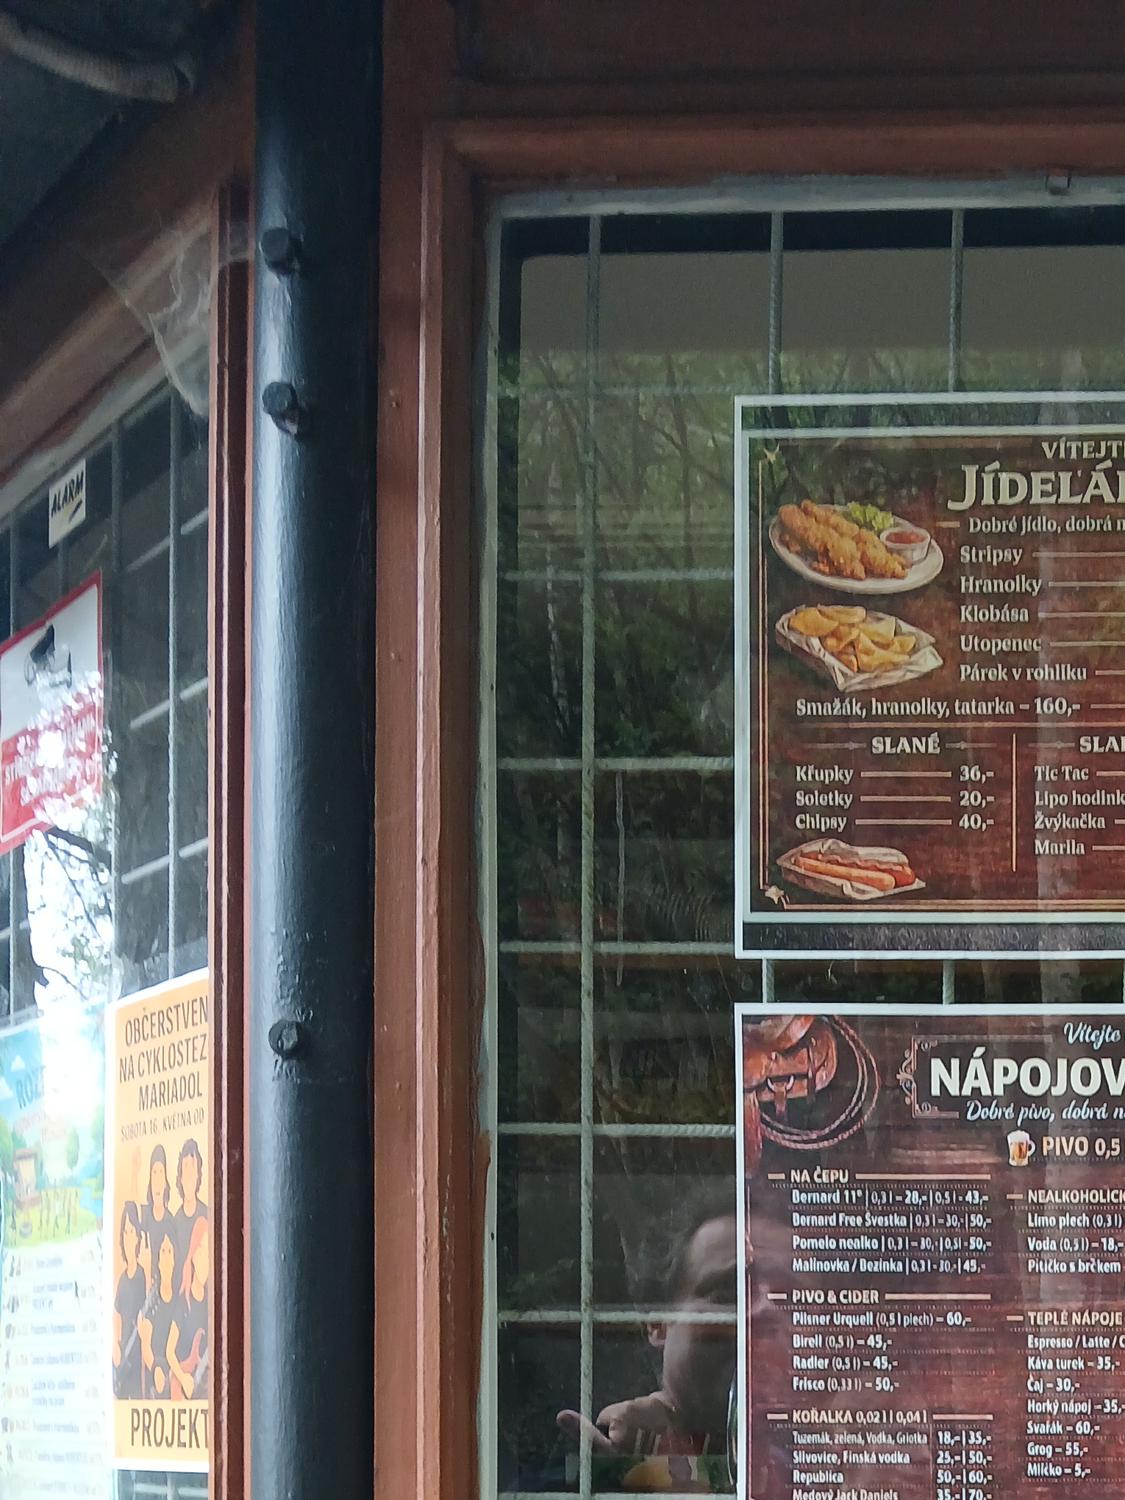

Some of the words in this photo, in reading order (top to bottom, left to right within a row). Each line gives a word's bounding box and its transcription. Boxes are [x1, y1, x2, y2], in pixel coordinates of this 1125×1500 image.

[51, 470, 84, 518] ALARM
[969, 516, 1017, 533] Dobré
[1021, 515, 1061, 534] jídlo,
[1066, 514, 1112, 532] dobrá
[960, 546, 1022, 566] Stripsy
[960, 575, 1041, 596] Hranolky
[960, 604, 1029, 622] Klobása
[960, 634, 1041, 655] Utopenec
[960, 664, 1008, 682] Párek
[796, 697, 866, 717] Smažák,
[871, 697, 950, 718] hranolky,
[955, 699, 1014, 716] tatarka
[872, 731, 940, 754] SLANÉ
[795, 765, 853, 784] Křupky
[1034, 765, 1058, 782] Tic
[1061, 765, 1089, 782] Tac
[796, 790, 852, 808] Soletky
[1035, 791, 1068, 809] Lipo
[795, 814, 846, 832] Chipsy
[1034, 811, 1106, 832] Žvýkačka
[1064, 1022, 1120, 1049] Vítejte
[120, 1056, 135, 1083] NA
[138, 1034, 207, 1078] CYKLOSTEZ
[139, 1071, 202, 1111] MARIADOL
[966, 1100, 1014, 1121] Dobré
[1018, 1101, 1055, 1125] pivo,
[1062, 1100, 1108, 1120] dobrá
[1042, 1136, 1089, 1156] PIVO
[791, 1169, 810, 1183] NA
[814, 1166, 848, 1183] ČEPU
[792, 1189, 840, 1204] Bernard
[792, 1212, 836, 1226] Bernard
[839, 1214, 862, 1226] Free
[864, 1208, 907, 1226] Švestka
[1028, 1213, 1056, 1228] Limo
[1059, 1213, 1090, 1230] plech
[793, 1235, 836, 1249] Pomelo
[839, 1235, 878, 1249] nealko
[1028, 1237, 1057, 1252] Voda
[793, 1258, 849, 1272] Malinovka
[859, 1258, 903, 1272] Bezinka
[1078, 1258, 1121, 1273] brčkem
[793, 1290, 824, 1304] PIVO
[840, 1290, 879, 1304] CIDER
[793, 1312, 831, 1325] Pilsner
[834, 1312, 873, 1328] Urquell
[1028, 1311, 1068, 1326] TEPLÉ
[1072, 1309, 1123, 1327] NÁPOJE
[793, 1334, 823, 1348] Birell
[1028, 1335, 1072, 1350] Espresso
[1083, 1335, 1110, 1348] Latte
[793, 1356, 829, 1370] Radler
[1028, 1356, 1053, 1370] Káva
[1056, 1356, 1084, 1370] turek
[793, 1377, 825, 1391] Frisco
[793, 1408, 852, 1424] KOŘALKA
[1028, 1399, 1060, 1415] Horký
[1062, 1399, 1091, 1415] nápoj
[131, 1408, 208, 1448] PROJEKT
[1027, 1420, 1062, 1435] Svařák
[843, 1451, 876, 1464] Finská
[879, 1451, 910, 1464] vodka
[1027, 1442, 1052, 1458] Grog
[793, 1470, 843, 1484] Republica
